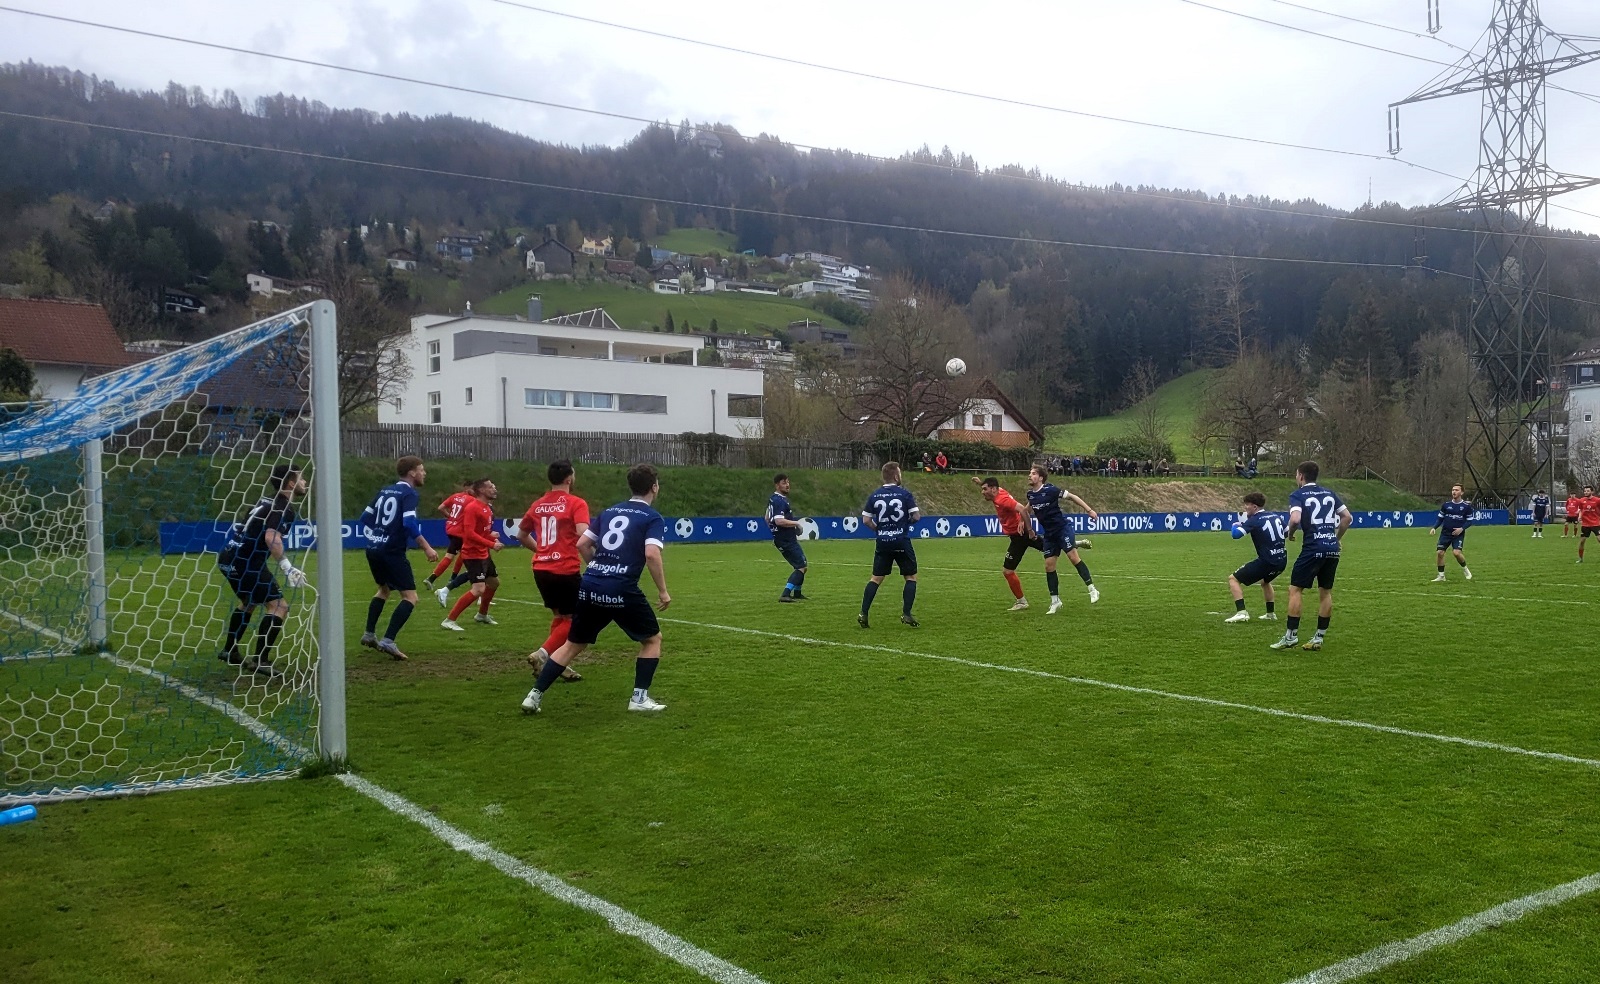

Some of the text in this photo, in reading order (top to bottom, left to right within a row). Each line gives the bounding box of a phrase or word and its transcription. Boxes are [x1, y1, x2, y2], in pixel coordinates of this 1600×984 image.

[375, 496, 397, 525] 19
[450, 503, 462, 518] 37
[874, 499, 904, 523] 23
[1305, 496, 1335, 524] 22
[541, 516, 557, 547] 10
[601, 515, 629, 550] 8
[1087, 516, 1119, 531] SIND
[1122, 516, 1154, 531] 100%
[1262, 518, 1285, 541] 16
[587, 560, 629, 574] Mangold
[590, 591, 625, 604] Helbok
